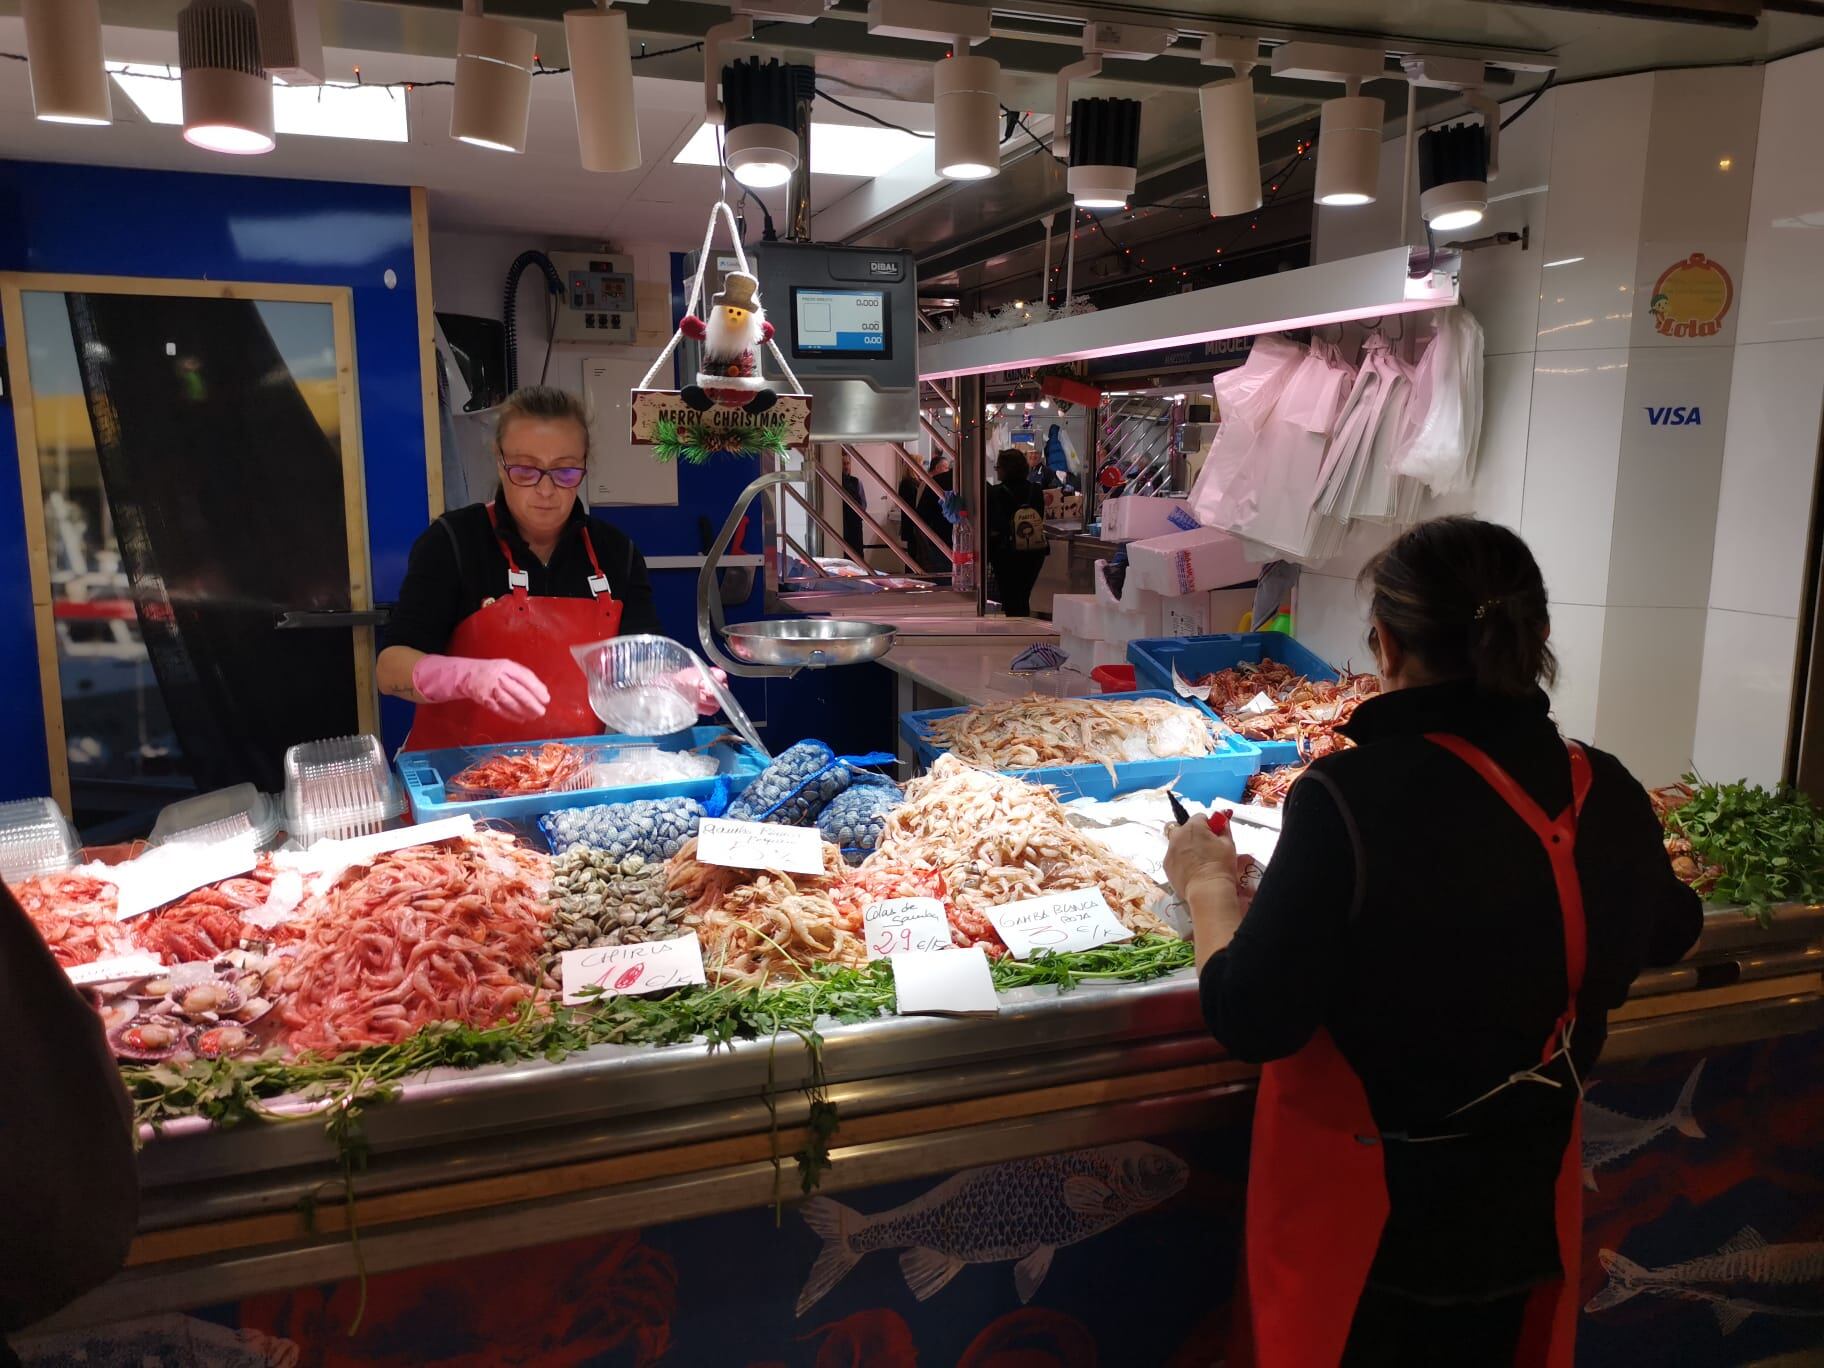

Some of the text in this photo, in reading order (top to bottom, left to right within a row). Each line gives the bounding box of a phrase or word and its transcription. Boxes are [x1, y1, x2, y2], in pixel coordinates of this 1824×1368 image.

[870, 263, 897, 272] DIBAL
[1656, 318, 1721, 337] Lola
[1205, 336, 1251, 356] MIGUEL
[658, 409, 786, 427] MERRY CHRISTMAS
[1645, 407, 1702, 425] VISA
[866, 902, 918, 922] Colas de
[1000, 901, 1099, 928] GAMBA BLANCA
[873, 928, 912, 955] 29
